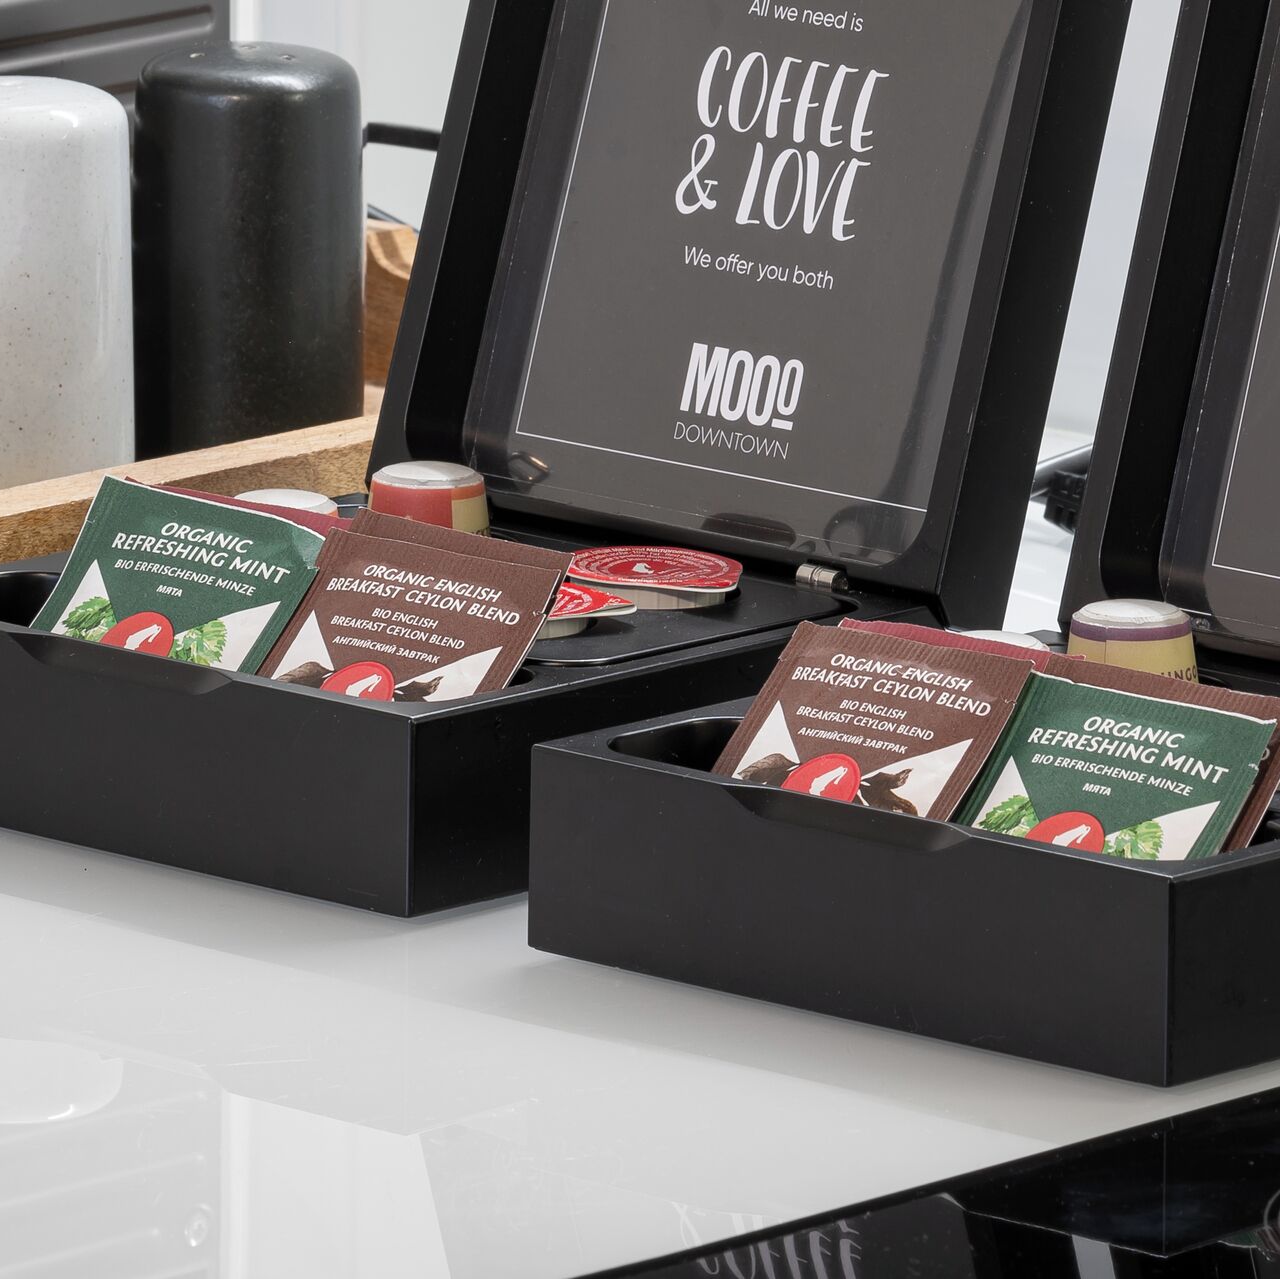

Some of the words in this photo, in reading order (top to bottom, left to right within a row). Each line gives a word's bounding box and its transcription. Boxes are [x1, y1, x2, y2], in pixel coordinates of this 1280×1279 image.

[775, 4, 799, 22] we
[801, 9, 848, 30] need
[850, 15, 864, 32] is
[696, 45, 890, 153] COFFEE
[674, 133, 719, 215] &
[734, 141, 872, 242] LOVE
[684, 245, 712, 268] We
[715, 253, 755, 276] offer
[756, 263, 790, 283] you
[793, 264, 834, 290] both
[673, 421, 790, 460] DOWNTOWN
[161, 522, 254, 554] ORGANIC
[111, 532, 229, 568] REFRESHING
[229, 556, 291, 584] MINT
[114, 559, 133, 570] BIO
[134, 562, 216, 586] ERFRISCHENDE
[215, 578, 257, 597] MINZE
[156, 584, 183, 597] МЯТА
[363, 564, 435, 588] ORGANIC
[433, 578, 503, 604] ENGLISH
[326, 577, 405, 599] BREAKFAST
[405, 589, 466, 613] CEYLON
[467, 602, 520, 626] BLEND
[371, 607, 391, 619] BIO
[391, 611, 439, 629] ENGLISH
[330, 615, 387, 633] BREAKFAST
[386, 624, 430, 643] CEYLON
[429, 634, 466, 650] BLEND
[332, 635, 397, 655] АНГЛИЙСКИЙ
[396, 648, 441, 664] ЗАВТРАК
[791, 666, 873, 689] BREAKFAST
[873, 679, 935, 703] CEYLON
[936, 692, 992, 717] BLEND
[830, 653, 903, 677] ORGANIC
[901, 666, 974, 692] ENGLISH
[796, 705, 854, 723] BREAKFAST
[853, 715, 899, 732] CEYLON
[897, 723, 934, 741] BLEND
[839, 699, 859, 711] BIO
[860, 702, 908, 720] ENGLISH
[797, 726, 864, 745] АНГЛИЙСКИЙ
[863, 738, 909, 754] ЗАВТРАК
[1083, 716, 1185, 749] ORGANIC
[1027, 727, 1160, 764] REFRESHING
[1160, 752, 1230, 784] MINT
[1031, 753, 1054, 765] BIO
[1054, 756, 1147, 784] ERFRISCHENDE
[1146, 775, 1194, 797] MINZE
[1082, 782, 1112, 797] МЯТА
